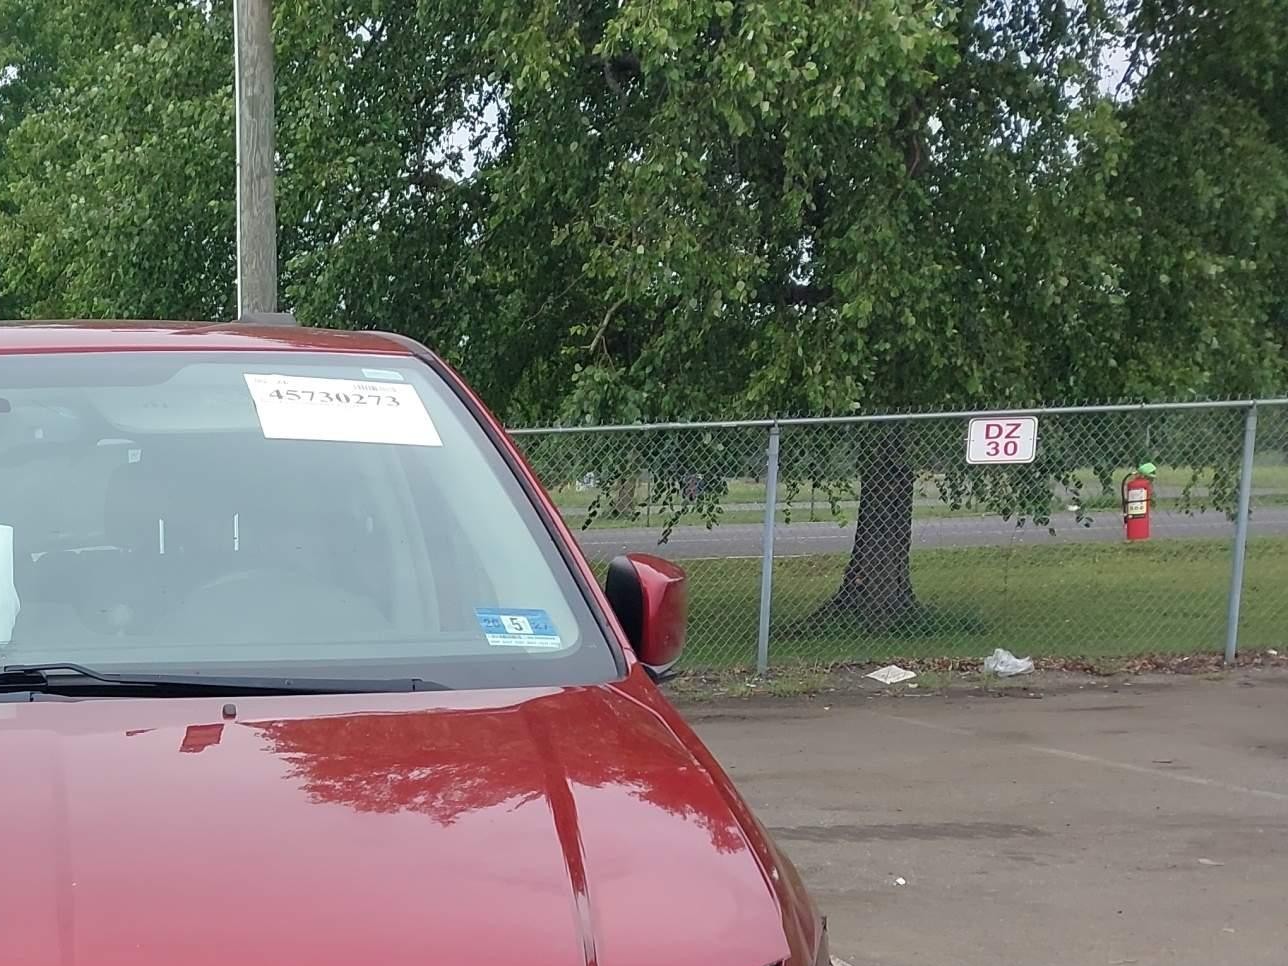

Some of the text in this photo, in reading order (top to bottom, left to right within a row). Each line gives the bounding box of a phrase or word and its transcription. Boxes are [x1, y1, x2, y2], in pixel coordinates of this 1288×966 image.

[269, 389, 401, 407] 45730273
[985, 423, 1022, 439] DZ
[986, 441, 1018, 456] 30
[509, 617, 523, 631] 5
